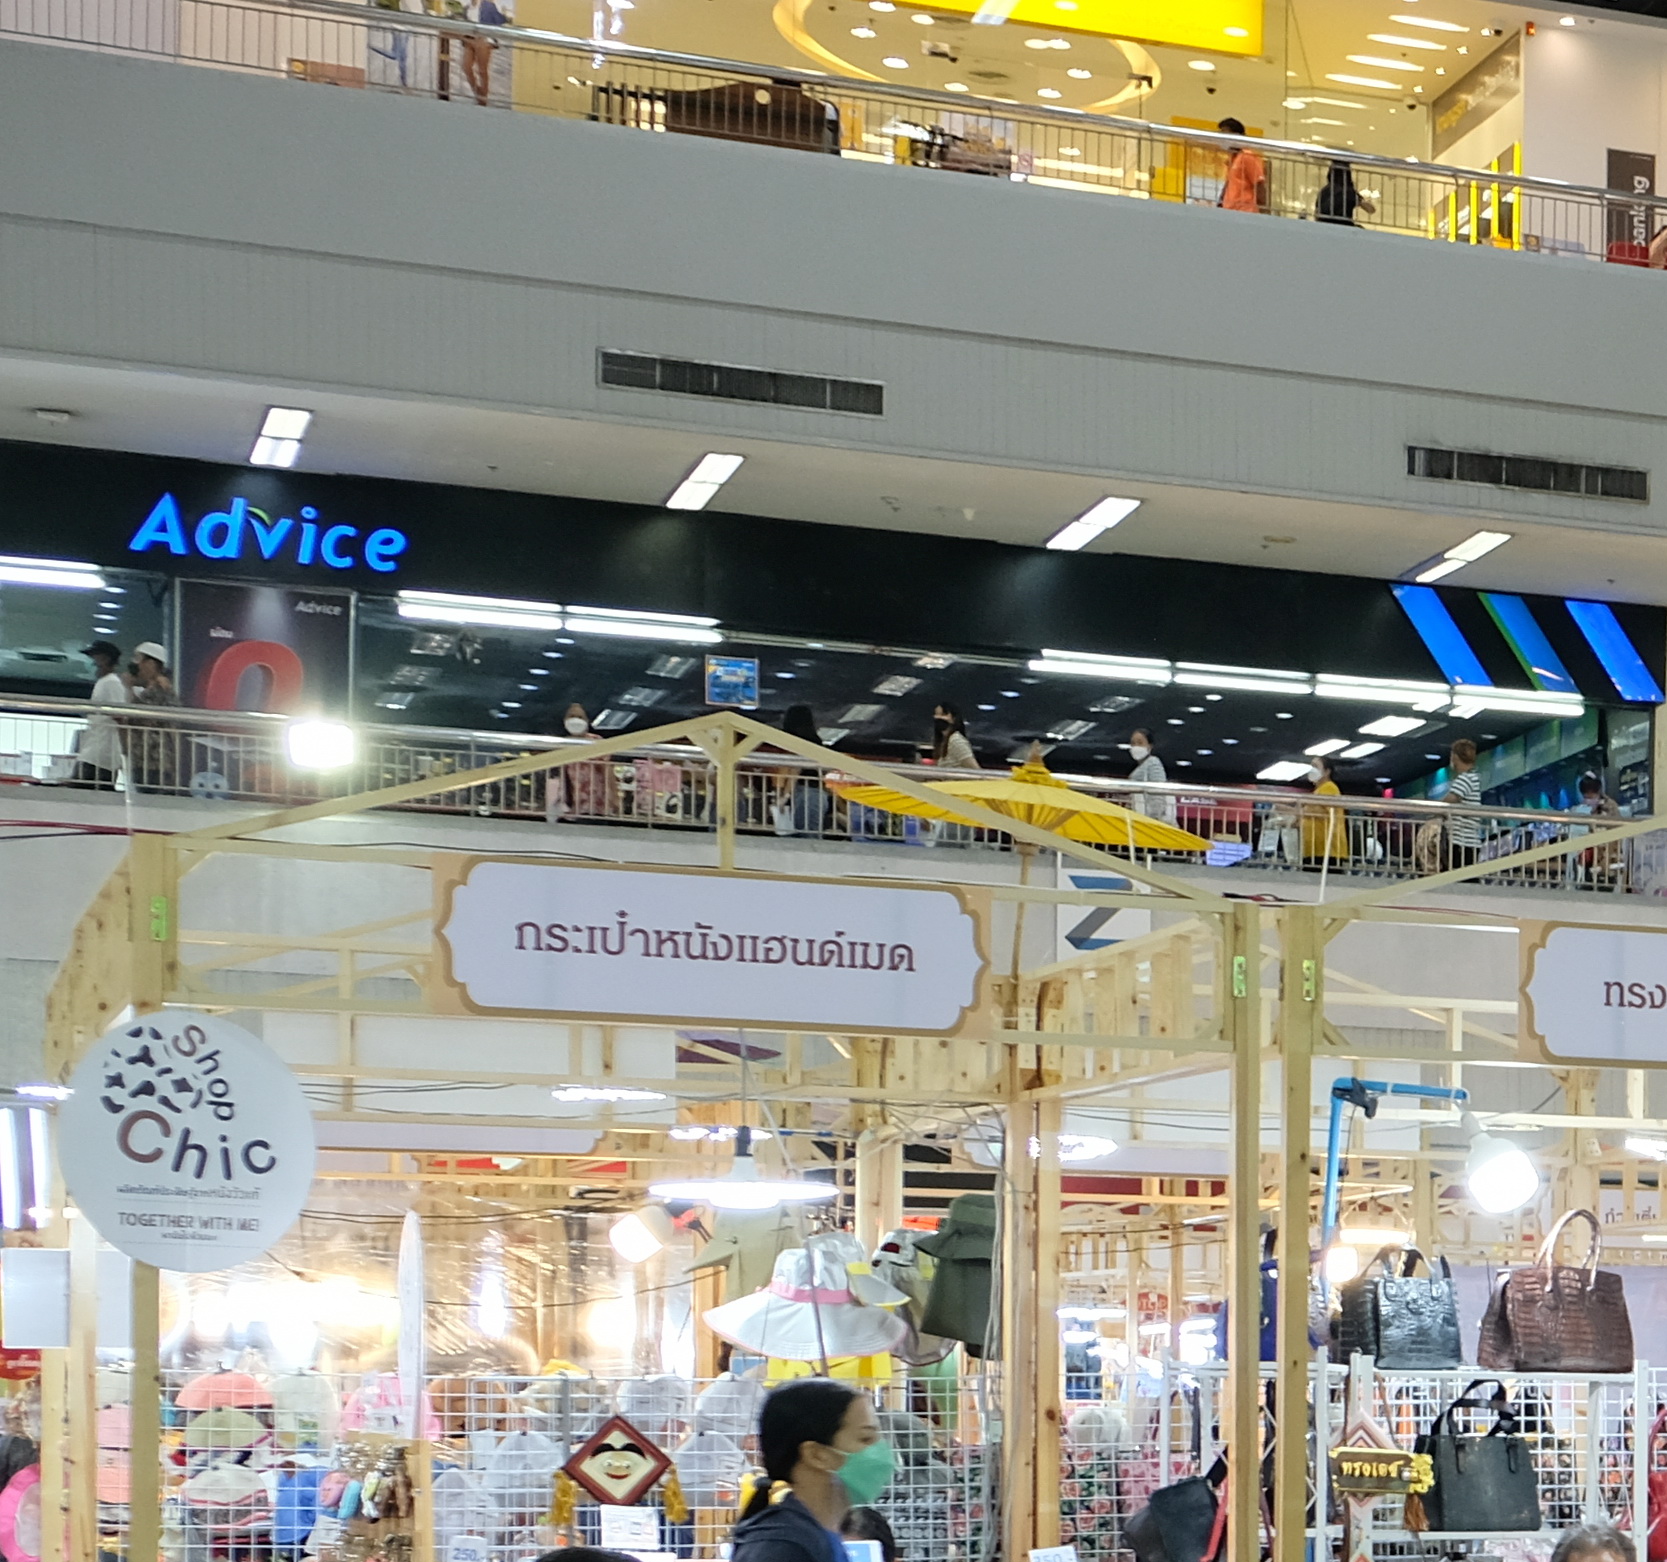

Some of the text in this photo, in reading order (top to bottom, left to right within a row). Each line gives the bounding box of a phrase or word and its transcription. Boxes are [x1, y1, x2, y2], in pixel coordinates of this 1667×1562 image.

[129, 492, 409, 573] Advice
[295, 600, 343, 616] Advice
[514, 909, 917, 973] กระเป๋าหนังแฮนด์เมด
[171, 1024, 236, 1121] Shop
[116, 1109, 277, 1181] Chic
[118, 1212, 194, 1228] TOGETHER
[199, 1214, 232, 1230] WITH
